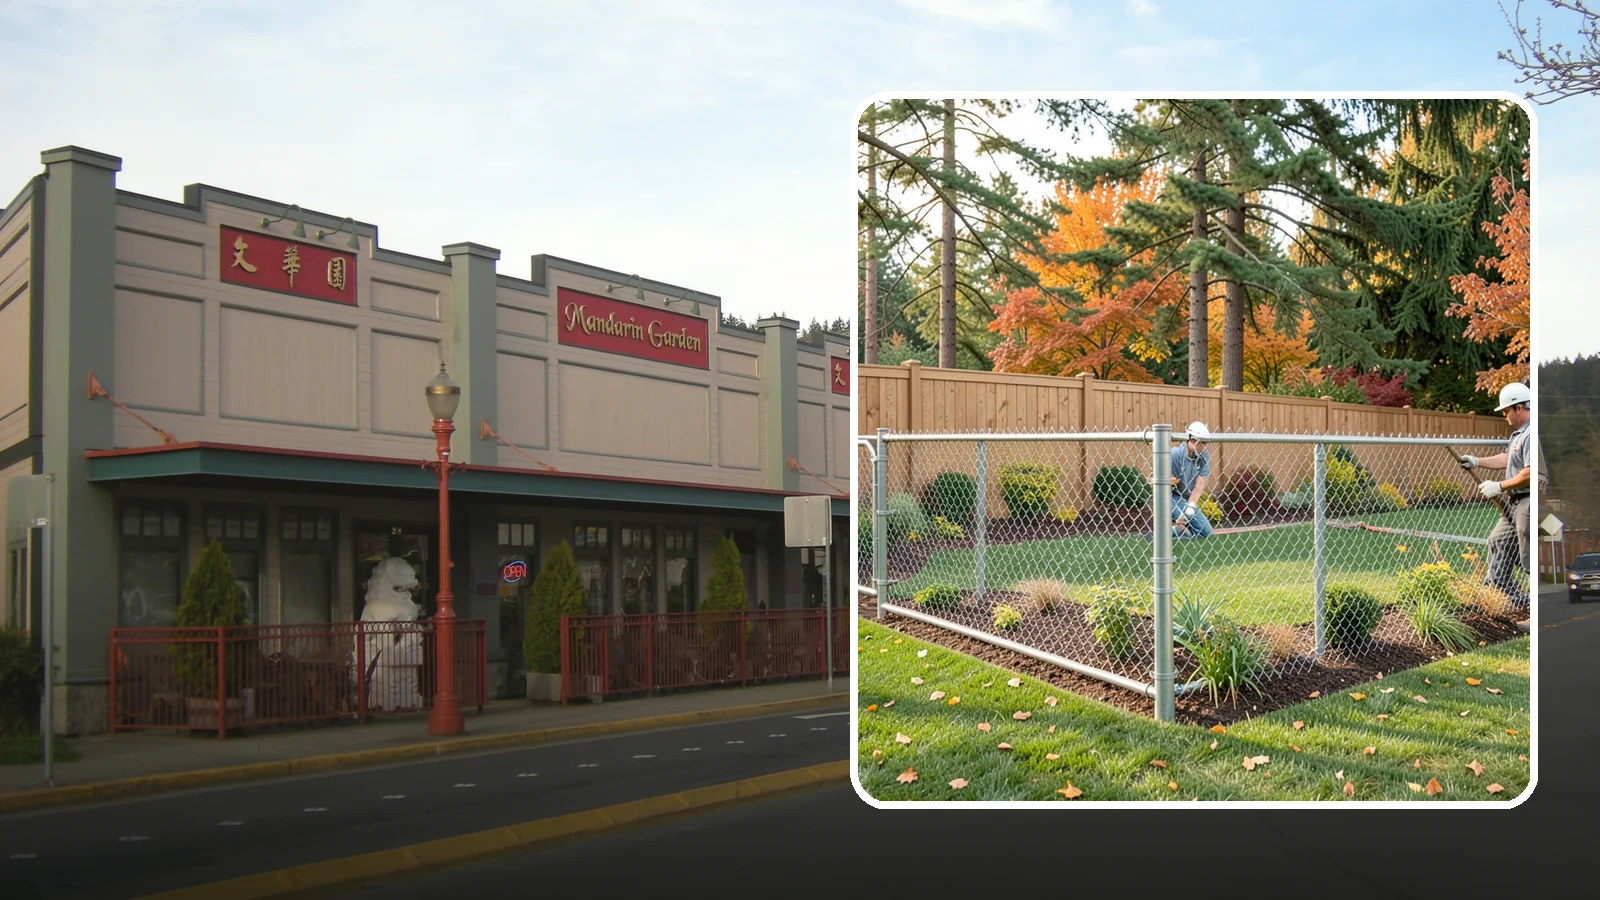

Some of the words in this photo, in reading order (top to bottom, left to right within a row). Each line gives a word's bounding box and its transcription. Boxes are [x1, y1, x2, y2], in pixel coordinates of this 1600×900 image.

[230, 235, 346, 291] 文華園
[564, 302, 644, 341] Mandarin
[647, 320, 701, 352] Garden
[503, 565, 527, 578] OPEN
